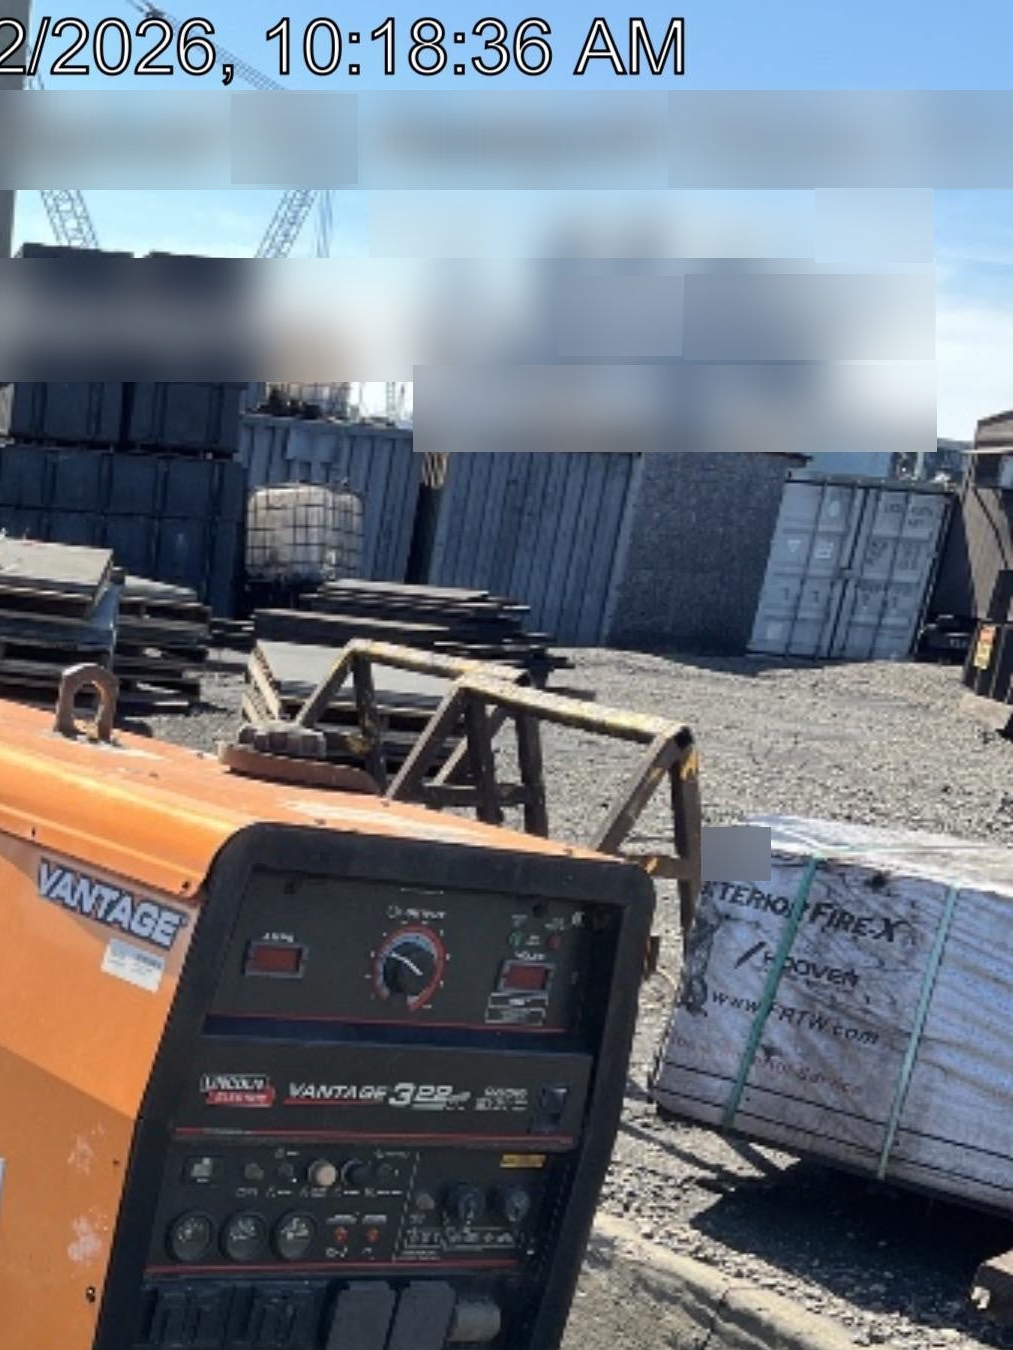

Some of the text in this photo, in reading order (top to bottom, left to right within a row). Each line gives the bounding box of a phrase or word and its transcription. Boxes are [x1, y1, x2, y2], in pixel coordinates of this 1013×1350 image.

[39, 862, 181, 947] VANTAGE
[712, 991, 879, 1046] wwwFRTW.com
[288, 1081, 388, 1101] VANTAGE
